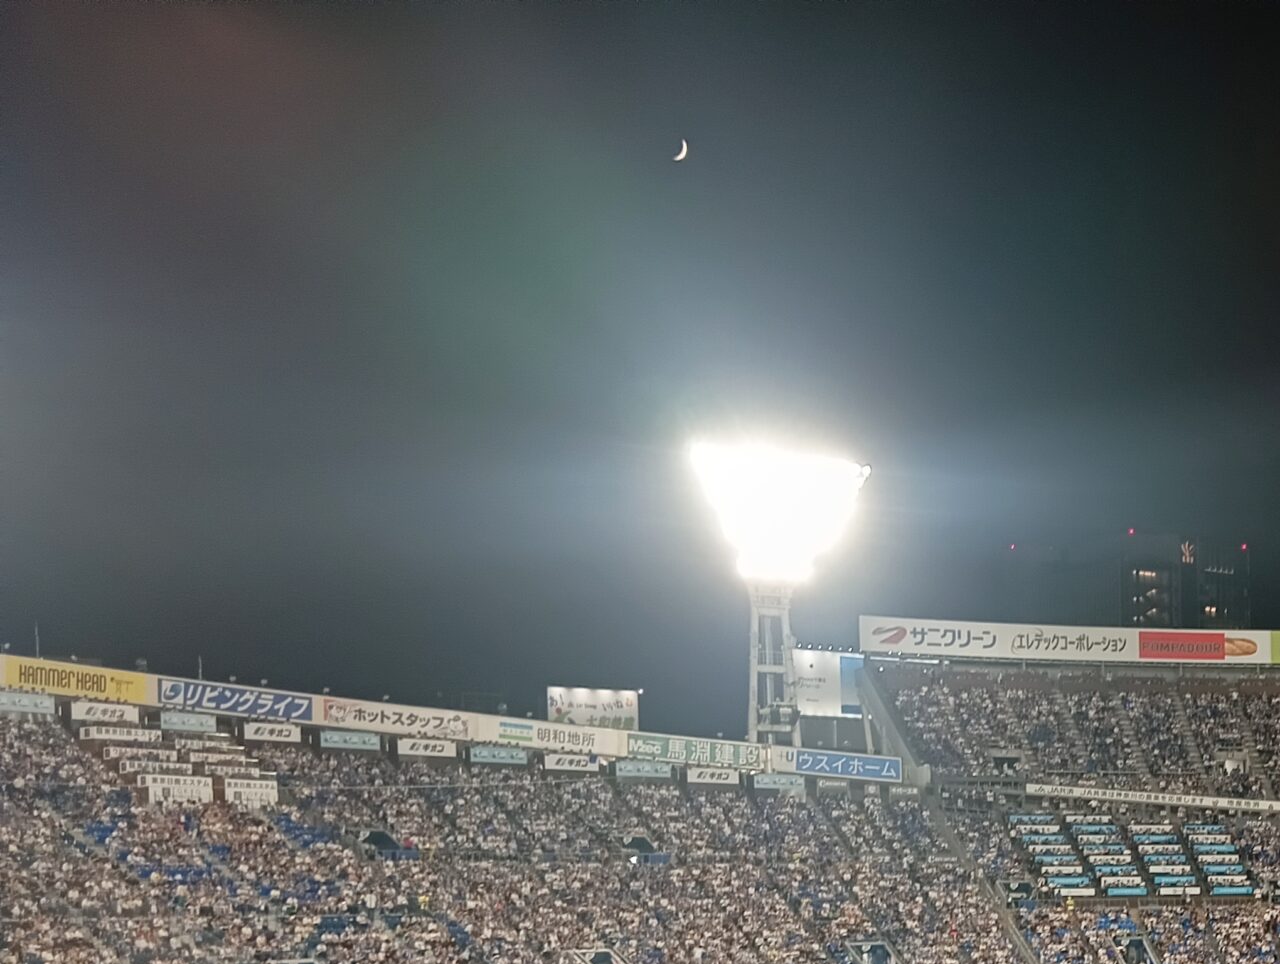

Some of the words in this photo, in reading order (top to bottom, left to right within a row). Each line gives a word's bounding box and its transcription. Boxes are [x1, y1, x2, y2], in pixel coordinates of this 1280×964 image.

[910, 627, 996, 649] サニクリーン
[186, 684, 310, 718] リビングライフ
[353, 708, 444, 730] ホットスタッフ
[537, 727, 596, 748] 明和地所
[799, 753, 897, 778] ウスイホーム
